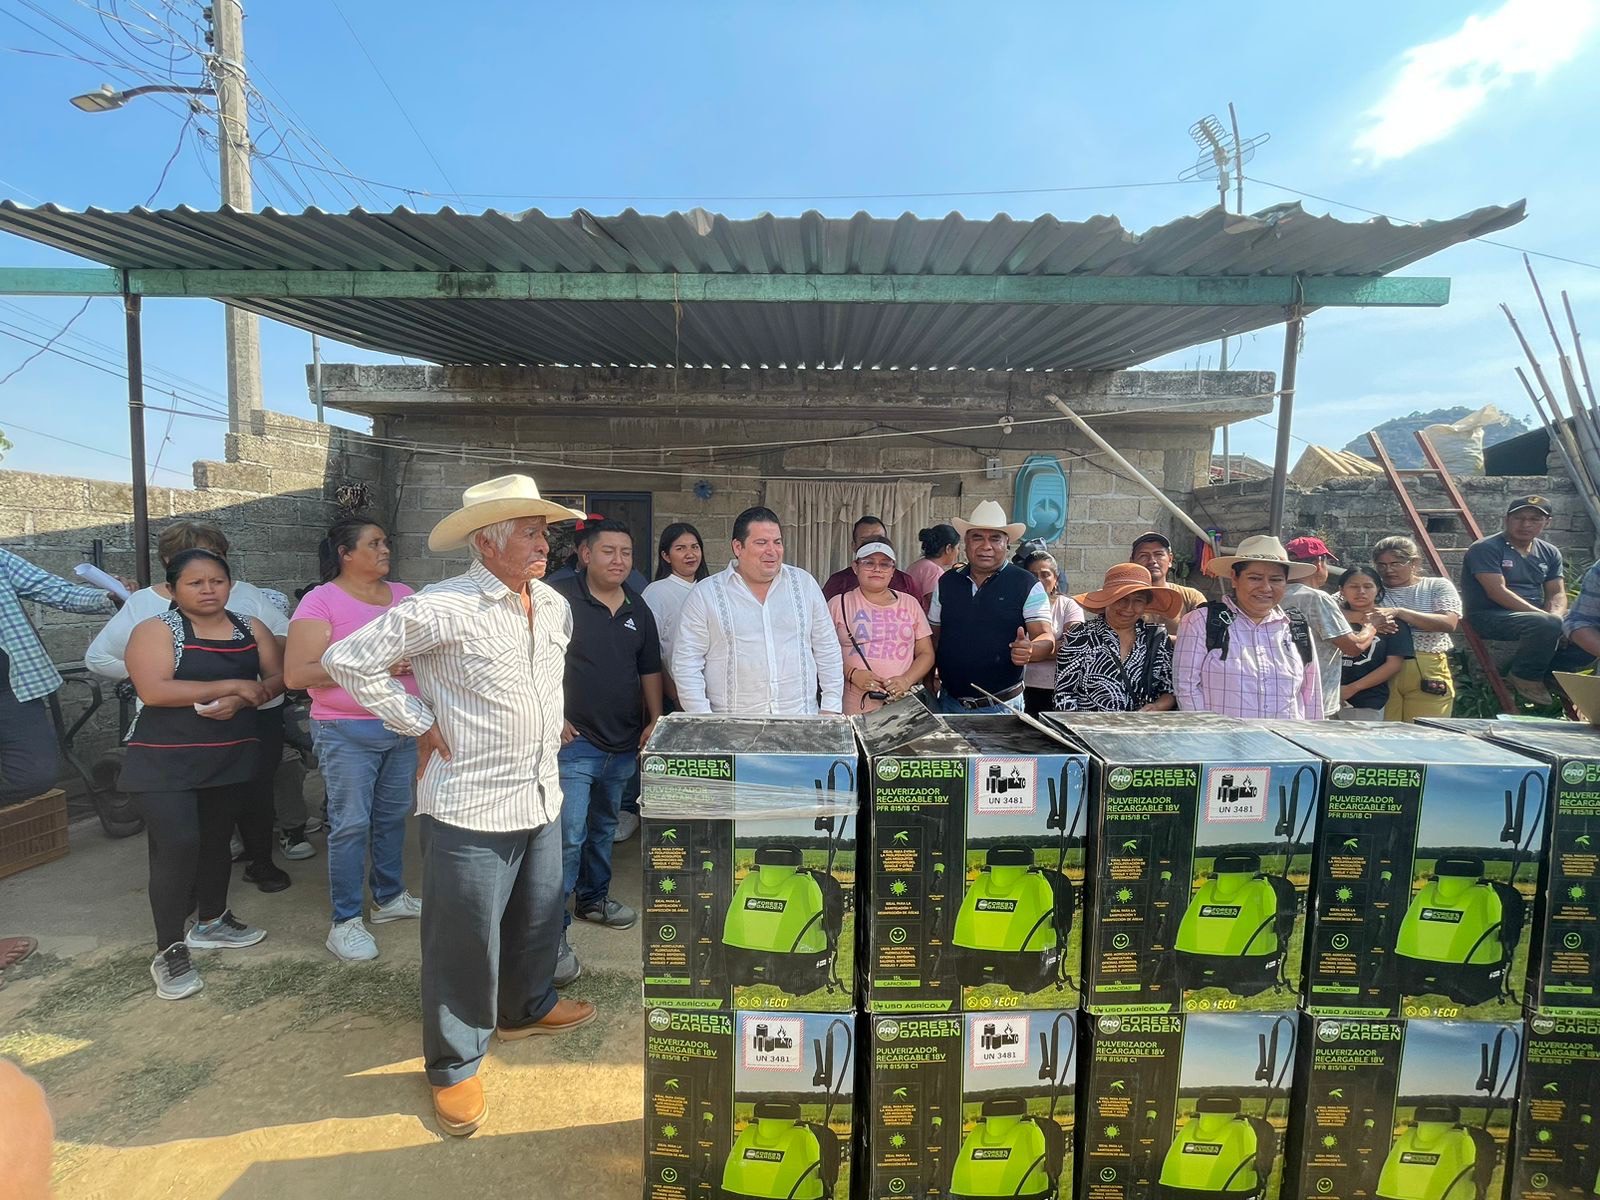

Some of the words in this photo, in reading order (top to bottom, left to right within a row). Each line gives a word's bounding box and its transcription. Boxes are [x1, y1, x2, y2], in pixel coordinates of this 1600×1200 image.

[854, 622, 914, 640] AERO
[667, 768, 730, 776] GARDEN
[901, 770, 964, 778] GARDEN
[1564, 768, 1584, 777] PRO
[1133, 778, 1196, 787] GARDEN
[1356, 777, 1420, 787] GARDEN
[1330, 795, 1394, 804] PULVERIZADOR
[1329, 803, 1386, 811] RECARGABLE
[769, 997, 788, 1008] ECO
[998, 997, 1018, 1006] ECO
[1218, 1000, 1236, 1010] ECO
[1438, 1008, 1458, 1018] ECO
[671, 1023, 732, 1034] GARDEN
[1121, 1024, 1180, 1032] GARDEN
[1555, 1025, 1600, 1034] GARD
[900, 1029, 960, 1038] GARDEN
[1340, 1032, 1401, 1040] GARDEN
[649, 1037, 709, 1048] PULVERIZADOR
[1529, 1040, 1593, 1050] PULVERIZADOR
[649, 1044, 702, 1055] RECARGABLE
[1096, 1048, 1150, 1056] RECARGABLE
[1529, 1048, 1585, 1057] RECARGABLE
[877, 1054, 930, 1062] RECARGABLE
